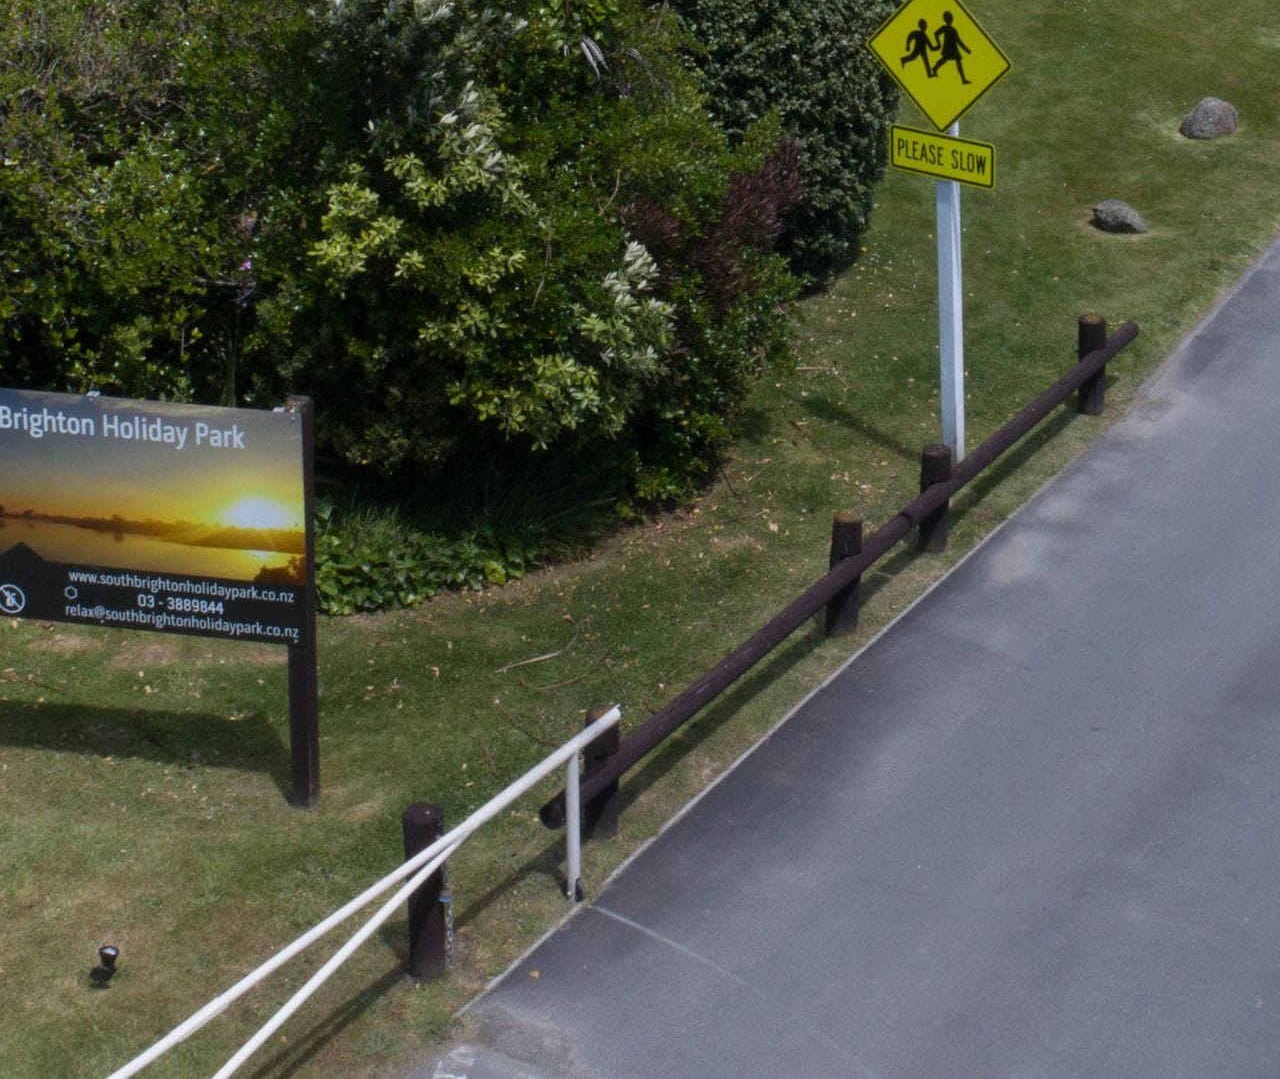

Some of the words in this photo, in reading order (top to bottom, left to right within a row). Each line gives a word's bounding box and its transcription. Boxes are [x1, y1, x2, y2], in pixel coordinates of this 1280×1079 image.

[897, 138, 944, 166] PLEASE
[951, 149, 986, 175] SLOW
[103, 413, 188, 450] Holiday
[195, 422, 246, 449] Park
[68, 571, 295, 603] www.southbrightonholidaypark.co.nz
[137, 593, 155, 608] 03
[167, 596, 224, 615] 3889844
[65, 603, 300, 638] relax@southbrightonholidaypark.co.nz
